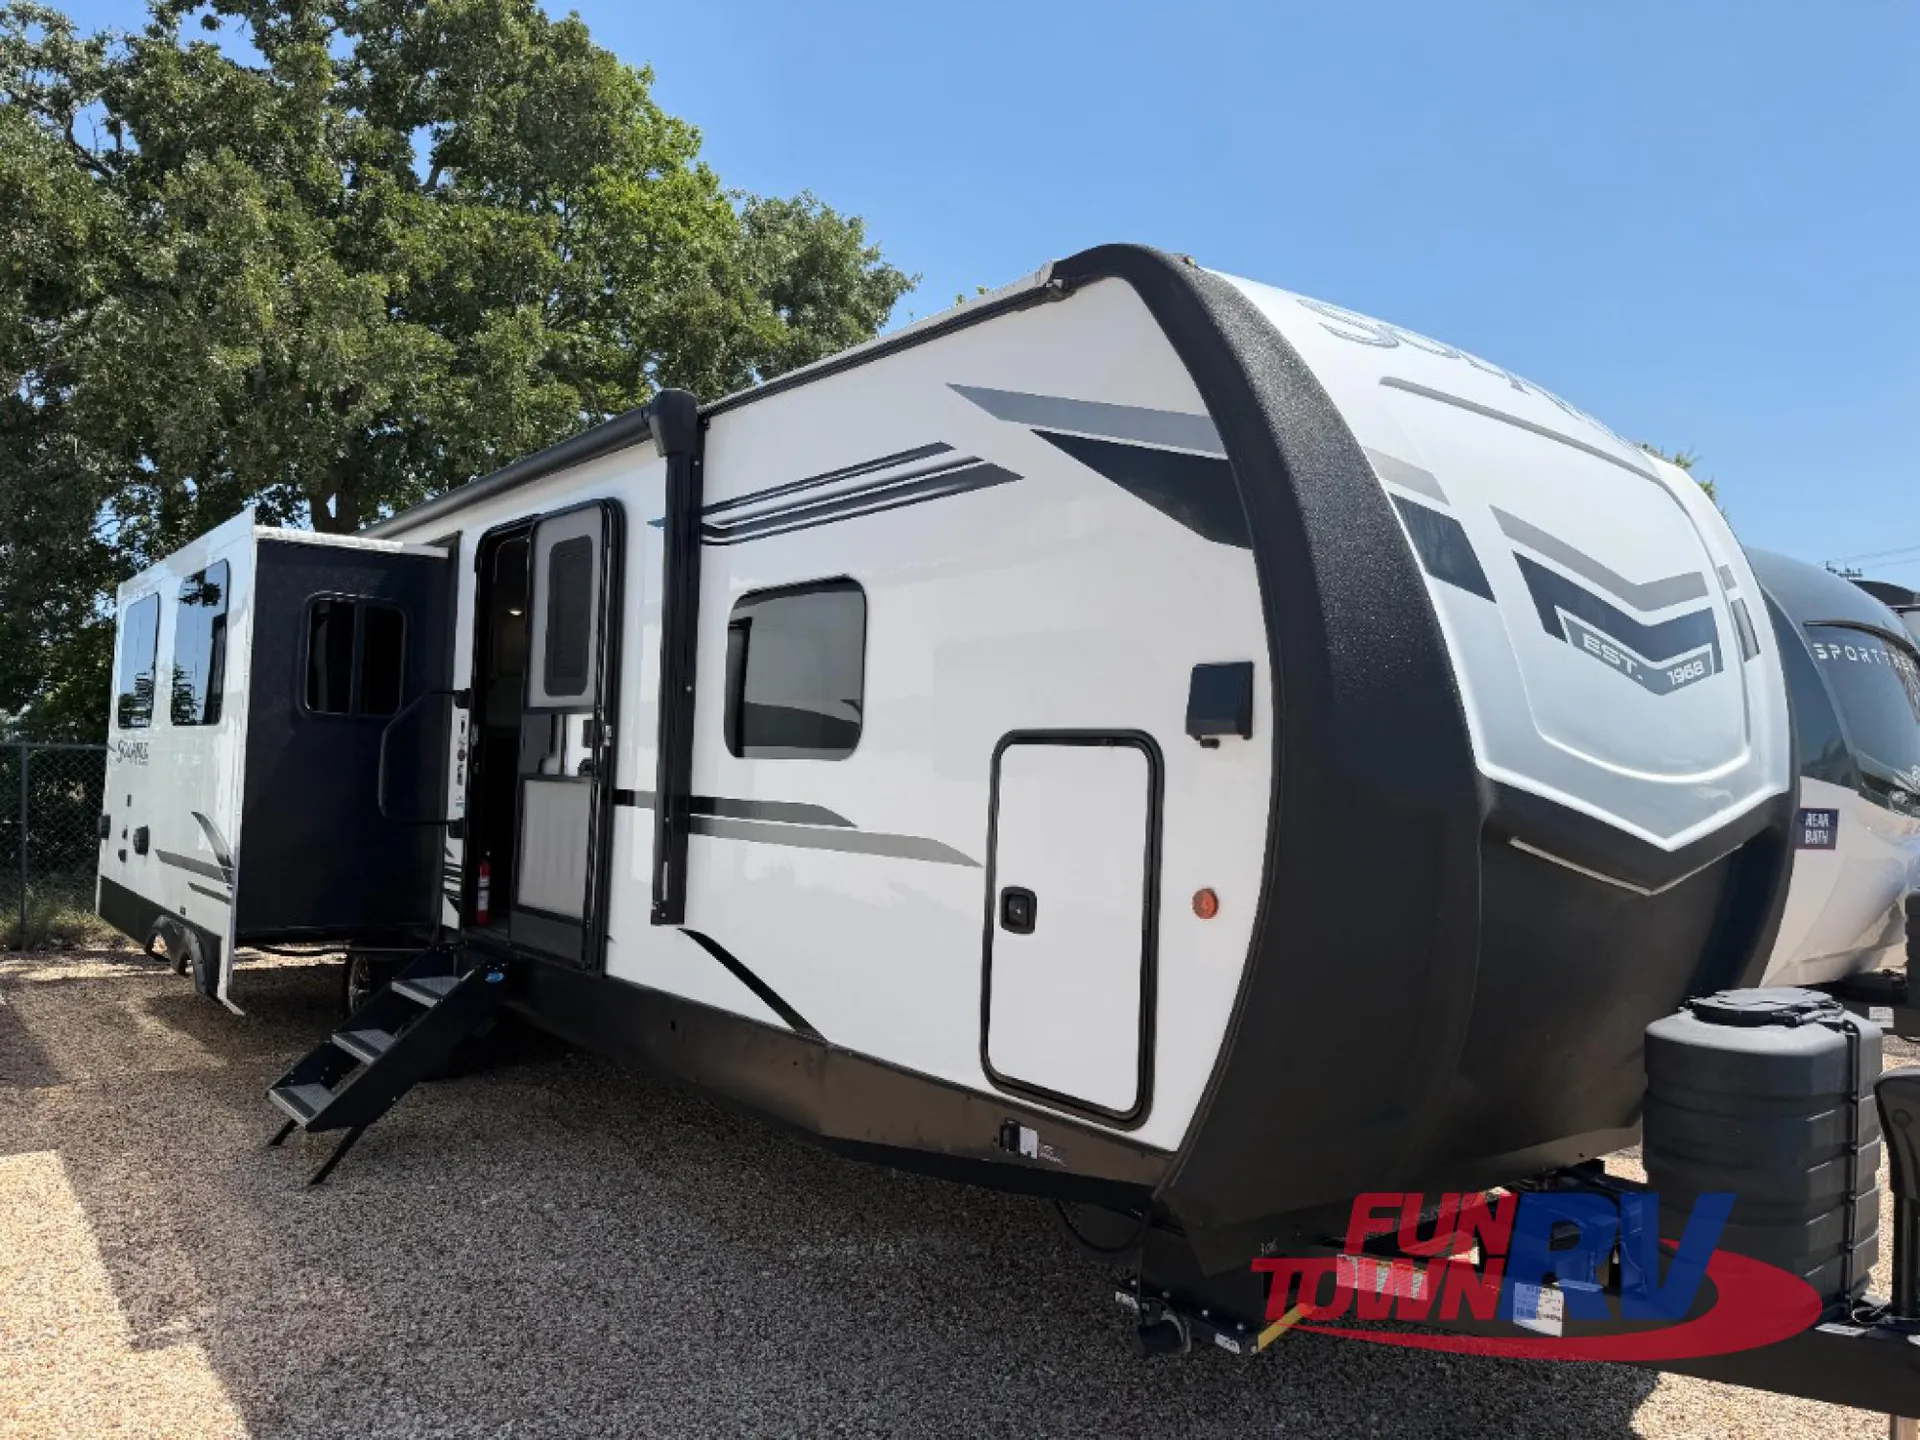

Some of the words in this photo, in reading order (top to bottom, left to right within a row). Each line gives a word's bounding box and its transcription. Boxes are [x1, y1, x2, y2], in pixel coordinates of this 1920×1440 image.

[1582, 633, 1644, 683] EST.
[1666, 660, 1705, 686] 1968
[1805, 812, 1829, 828] REAR
[1805, 829, 1829, 845] BATH
